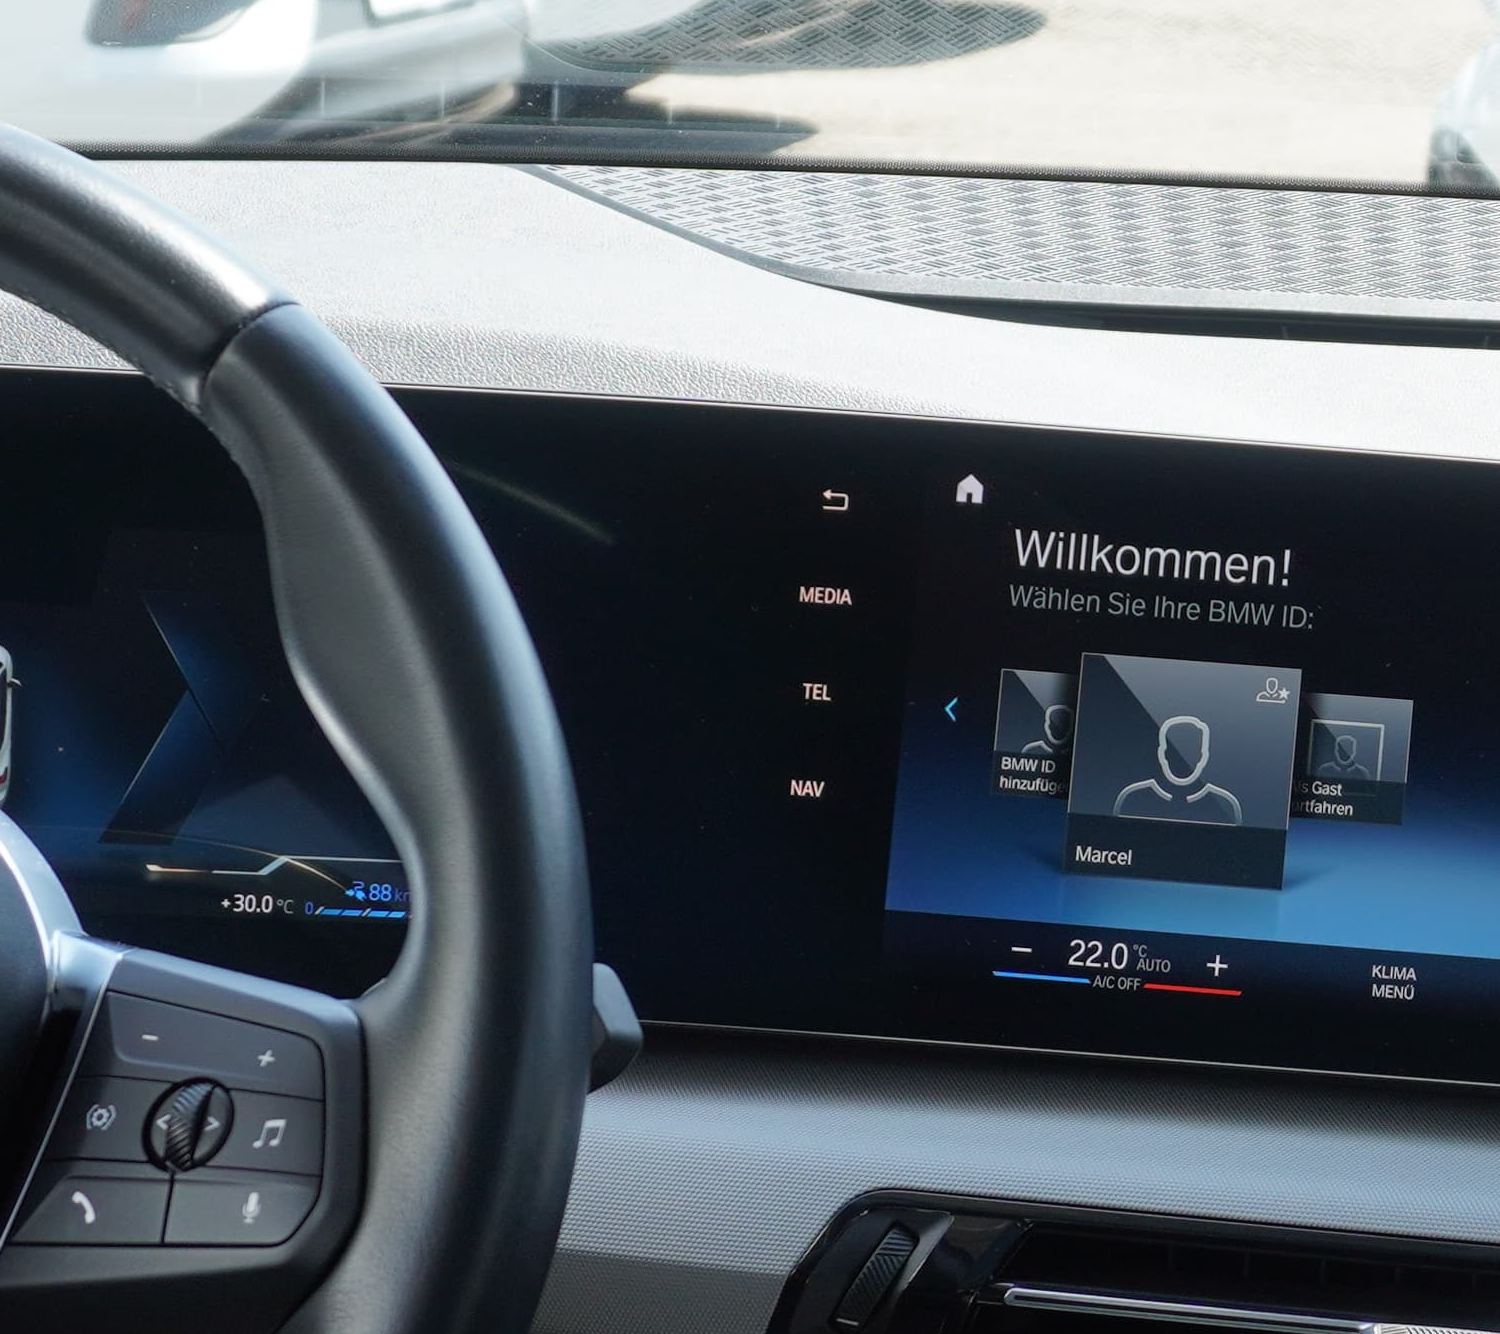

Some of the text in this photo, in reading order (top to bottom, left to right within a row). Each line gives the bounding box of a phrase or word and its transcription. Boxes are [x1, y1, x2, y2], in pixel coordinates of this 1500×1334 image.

[1014, 527, 1293, 587] Willkommen!
[799, 586, 852, 605] MEDIA
[1009, 582, 1315, 629] Wählen Sie Ihre BMW ID:
[803, 683, 831, 701] TEL
[1001, 756, 1056, 773] BMW ID
[790, 779, 825, 798] NAV
[1311, 780, 1342, 797] Gast
[1292, 799, 1354, 816] ortfahren
[1075, 845, 1132, 866] Marcel
[369, 883, 392, 901] 88
[221, 893, 294, 914] +30.0 °C
[1067, 938, 1147, 970] 22.0 °C
[1136, 957, 1171, 974] AUTO
[1371, 963, 1417, 981] KLIMA
[1092, 974, 1141, 991] A/C OFF
[1371, 982, 1415, 1001] MENÜ
